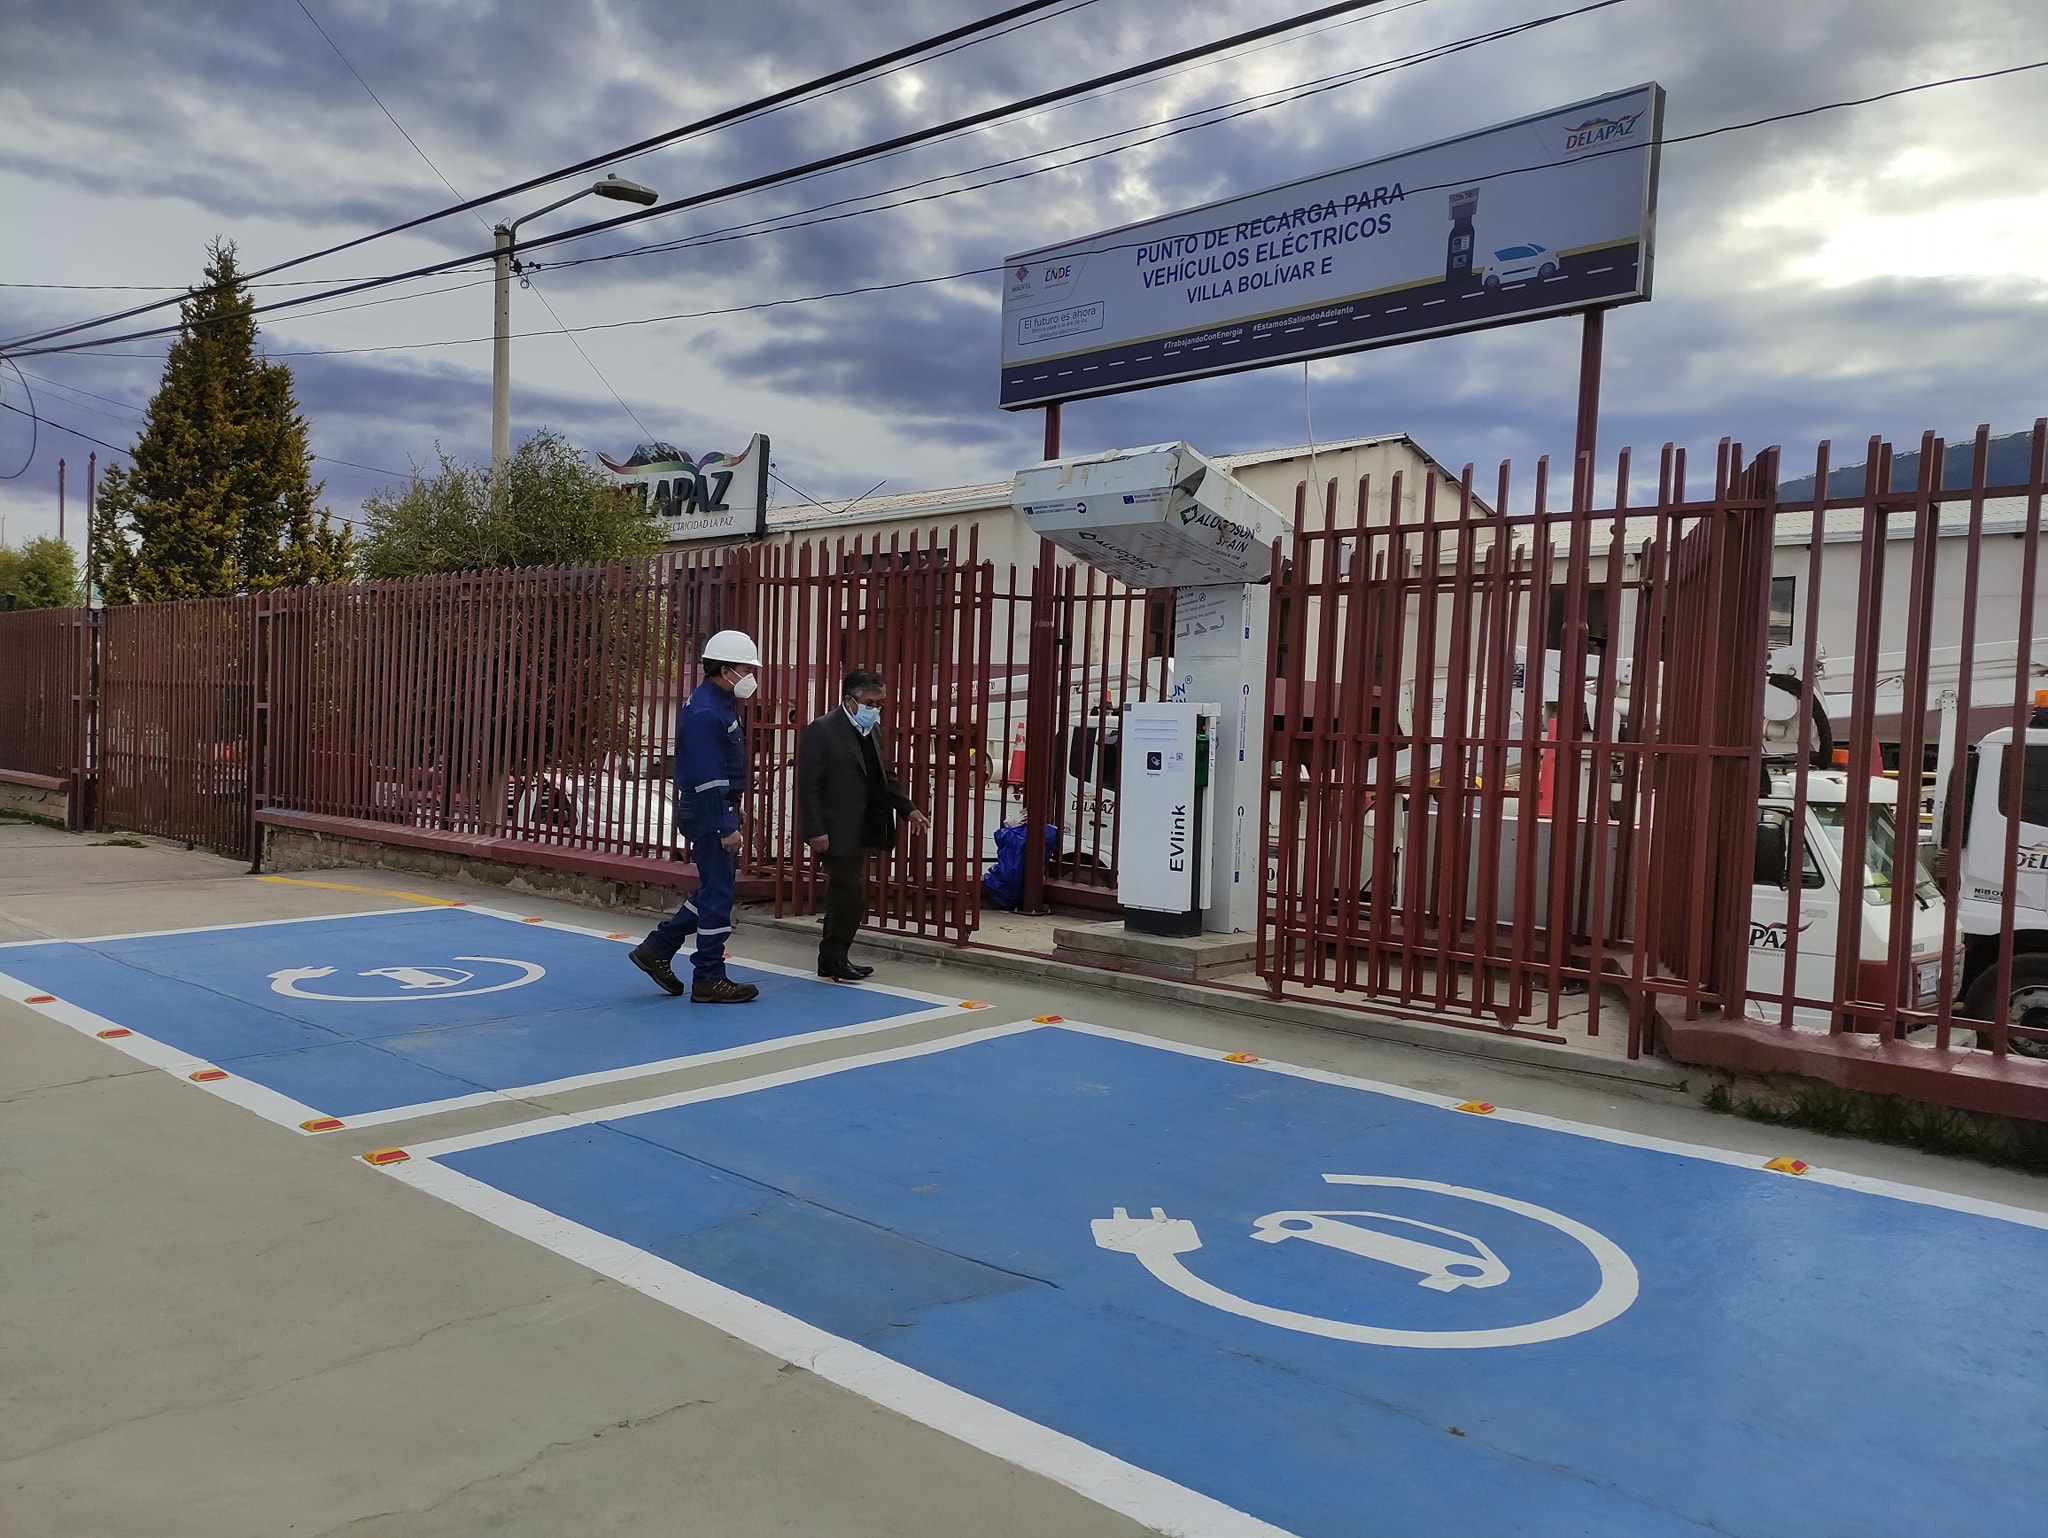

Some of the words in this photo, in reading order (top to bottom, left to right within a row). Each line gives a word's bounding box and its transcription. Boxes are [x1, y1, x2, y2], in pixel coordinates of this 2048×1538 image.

[1565, 120, 1637, 150] DELAPAZ
[1136, 235, 1198, 266] PUNTO
[1204, 229, 1229, 250] DE
[1235, 200, 1338, 242] RECARGA
[1344, 182, 1405, 216] PARA
[1143, 248, 1250, 289] VEHÍCULOS
[1256, 213, 1392, 263] ELÉCTRICOS
[1044, 265, 1072, 282] ENDE
[1187, 279, 1234, 304] VILLA
[1238, 261, 1315, 293] BOLÍVAR
[1321, 256, 1333, 275] E
[1024, 319, 1032, 330] El
[1034, 315, 1059, 327] futuro
[1061, 313, 1070, 322] es
[1072, 307, 1096, 319] ahora
[1163, 328, 1243, 350] #TrabajandoConEnergía
[1252, 306, 1354, 332] #EstamosSaliendoAdelante
[612, 471, 734, 516] LAPAZ
[710, 518, 718, 527] LA
[720, 516, 734, 526] PAZ
[1093, 540, 1159, 568] ALUCOSUN
[1072, 800, 1114, 815] DLAAZ
[1170, 804, 1186, 872] EVlink
[1974, 888, 2003, 897] NIBO
